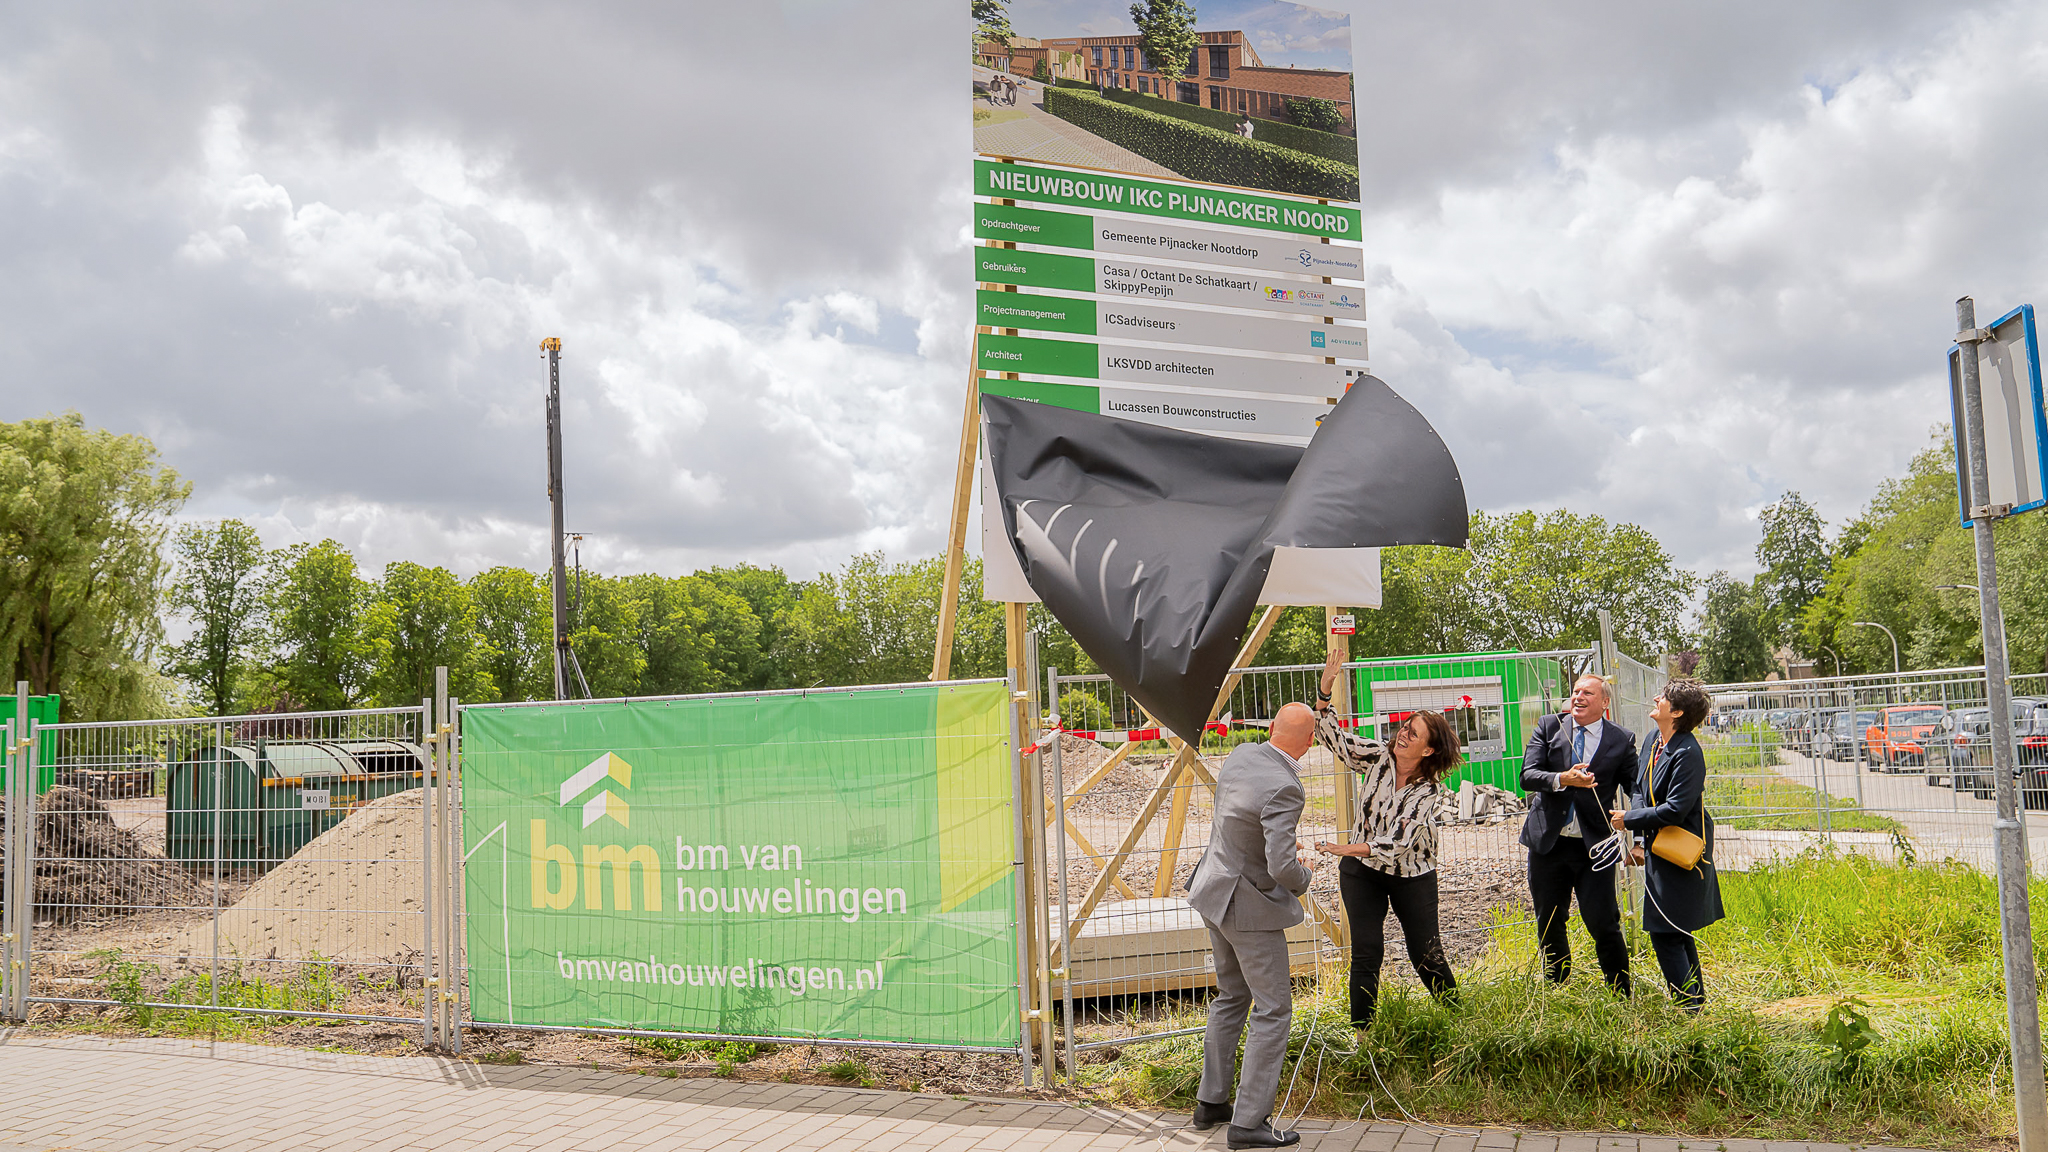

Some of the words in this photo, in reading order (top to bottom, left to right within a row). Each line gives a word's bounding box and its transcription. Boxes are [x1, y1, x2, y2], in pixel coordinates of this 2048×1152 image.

[989, 169, 1124, 204] NIEUWBOUW
[1129, 187, 1163, 209] IKC
[1168, 192, 1279, 225] PIJNACKER
[1283, 208, 1350, 233] NOORD
[981, 218, 1041, 233] Opdrachtgever
[1102, 229, 1157, 246] Gemeente
[1159, 236, 1208, 252] Pijnacker
[1211, 242, 1259, 259] Nootdorp
[982, 261, 1027, 274] Gebruikers
[1103, 265, 1130, 278] Casa
[1132, 268, 1138, 279] /
[1140, 268, 1176, 283] Octant
[1178, 272, 1193, 284] De
[1195, 274, 1251, 291] Schatkaart
[1252, 281, 1258, 292] /
[1104, 279, 1174, 298] SkippyPepijn
[983, 304, 1066, 320] Projectmanagement
[1105, 313, 1176, 330] ICSadviseurs
[1312, 335, 1324, 343] ICS
[1330, 338, 1362, 347] ADVISEURS
[985, 350, 1023, 361] Architect
[1107, 357, 1152, 371] LKSVDD
[1154, 361, 1215, 376] architecten
[1108, 400, 1160, 414] Lucassen
[1162, 404, 1257, 421] Bouwconstructies
[676, 836, 729, 870] bm
[740, 844, 802, 871] van
[530, 819, 662, 912] bm
[677, 878, 907, 923] houwelingen
[557, 951, 884, 997] bmvanhouwelingen.nl
